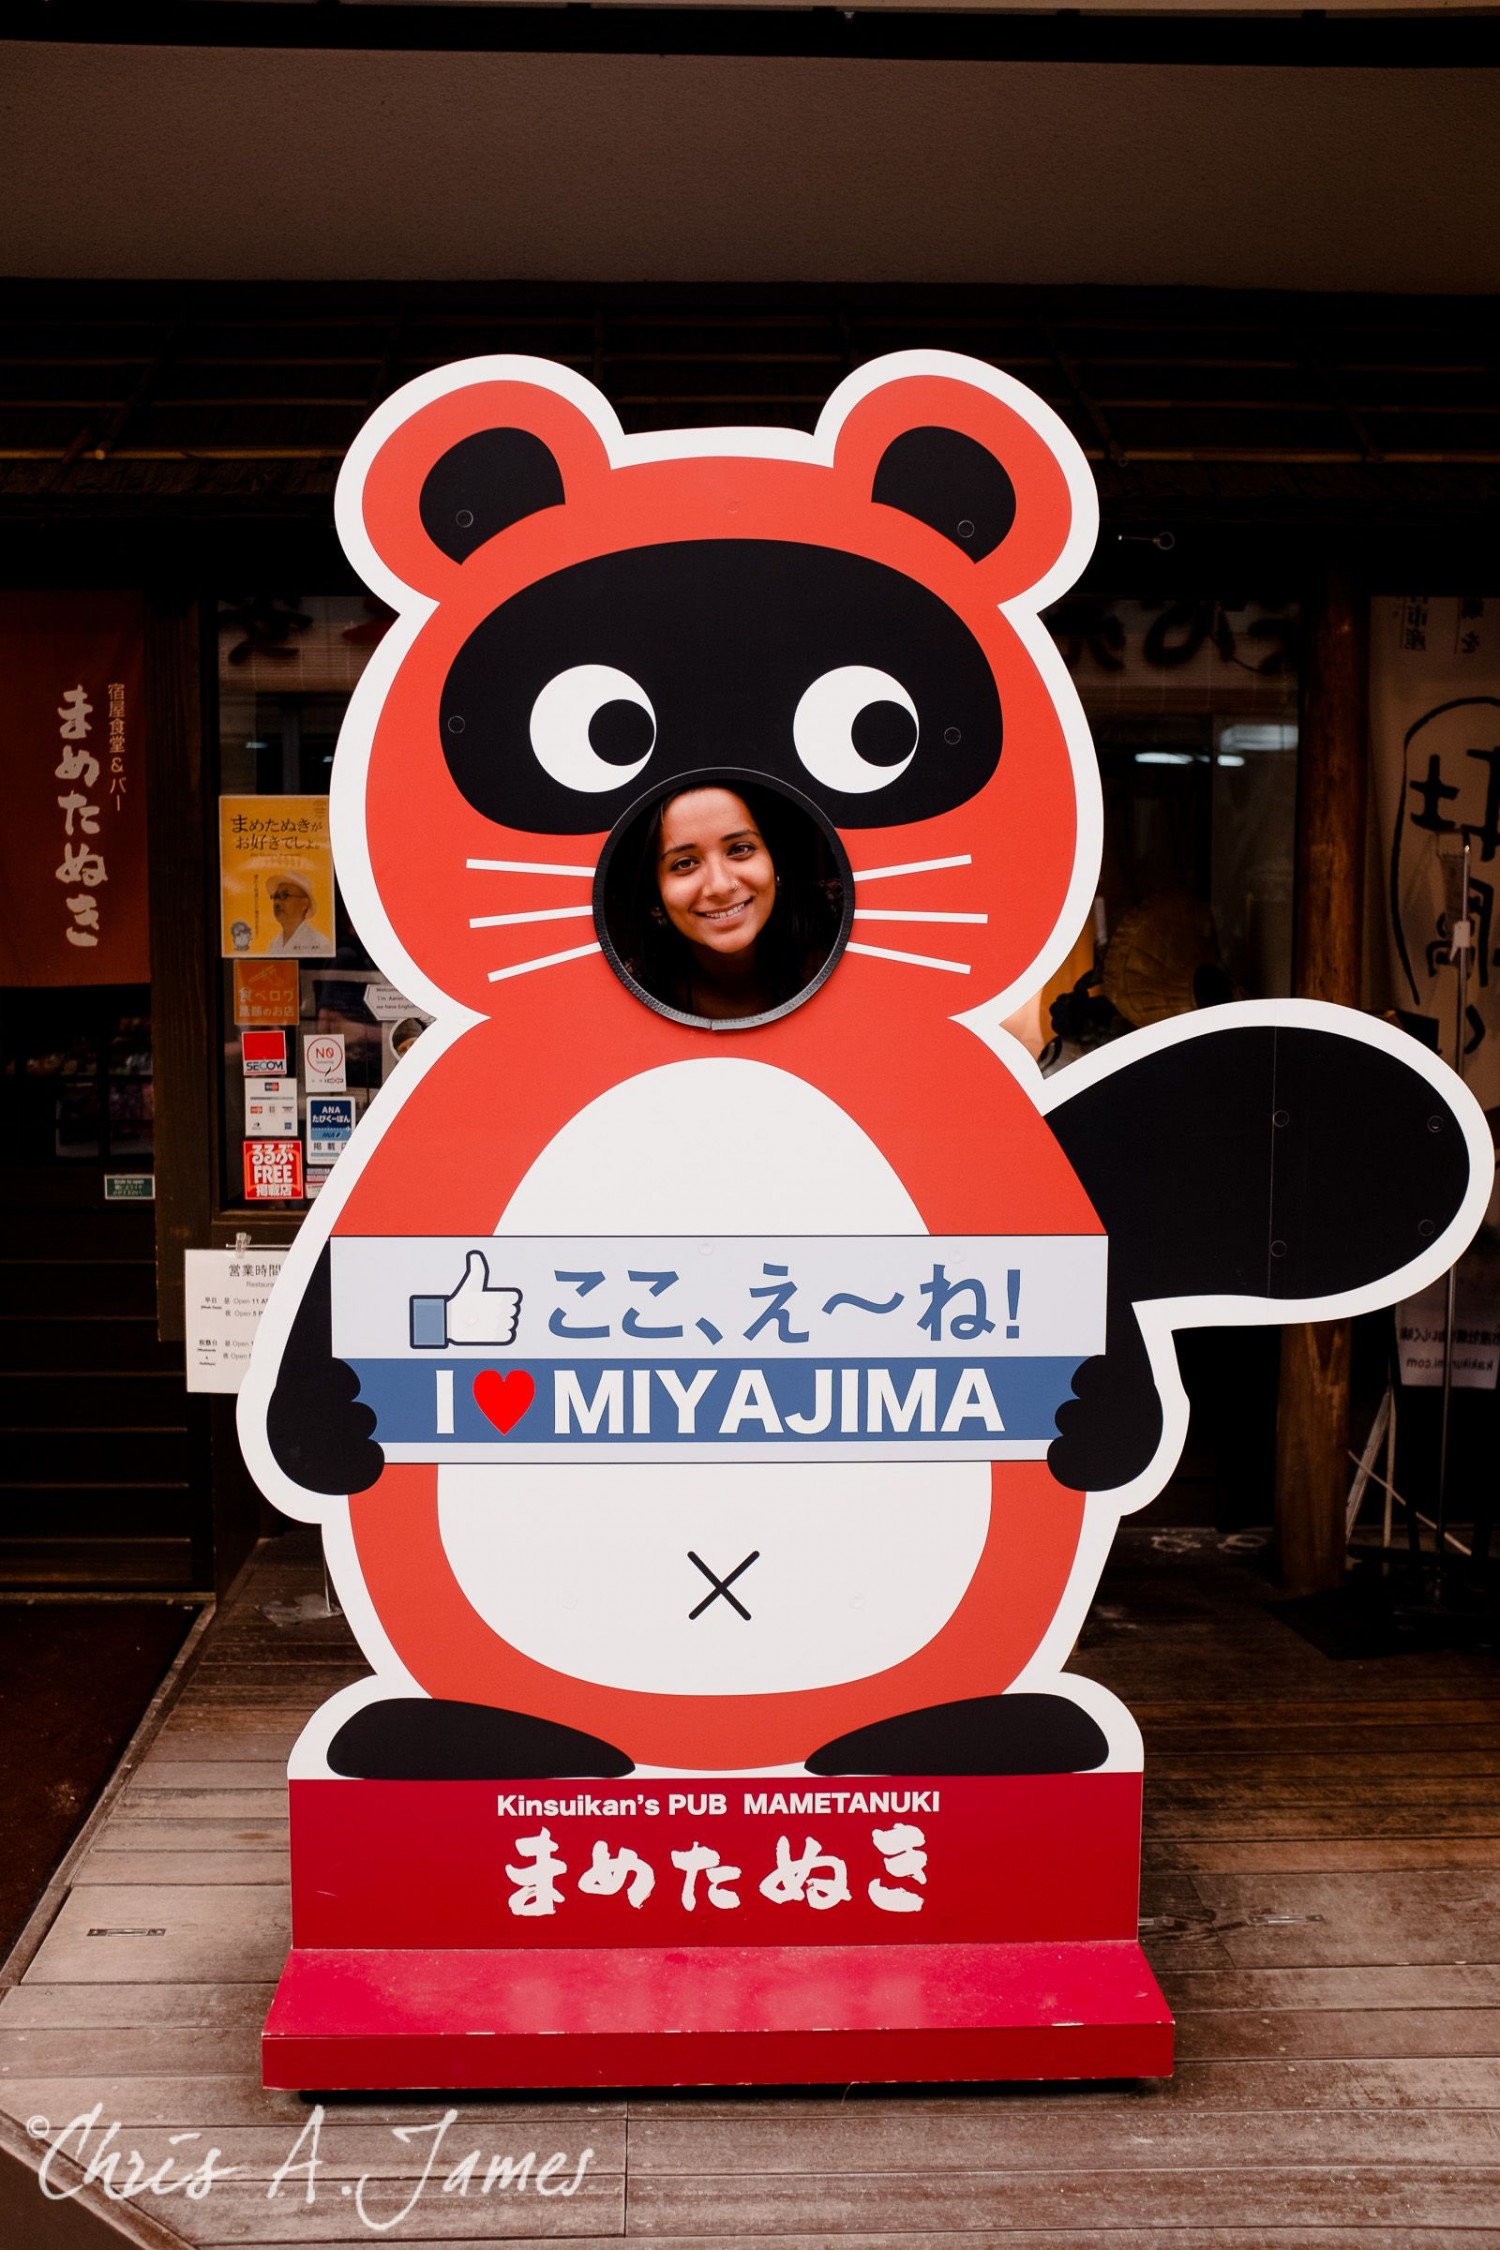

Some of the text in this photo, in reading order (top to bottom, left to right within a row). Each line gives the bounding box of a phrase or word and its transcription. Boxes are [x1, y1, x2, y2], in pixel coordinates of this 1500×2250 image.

[108, 682, 127, 812] 宿屋食堂&バー
[54, 683, 109, 948] まめたぬき
[231, 814, 323, 833] まめたぬきが
[236, 833, 321, 851] お好きでしょ。
[246, 1061, 284, 1073] SECOM
[322, 1106, 341, 1114] ANA
[251, 1143, 294, 1166] るるぶ
[253, 1164, 293, 1184] FREE
[435, 1367, 1006, 1435] I MIYAJIMA
[497, 1791, 940, 1816] Kinsuikan's PUB MAMETANUKI
[504, 1822, 930, 1917] まめたぬき
